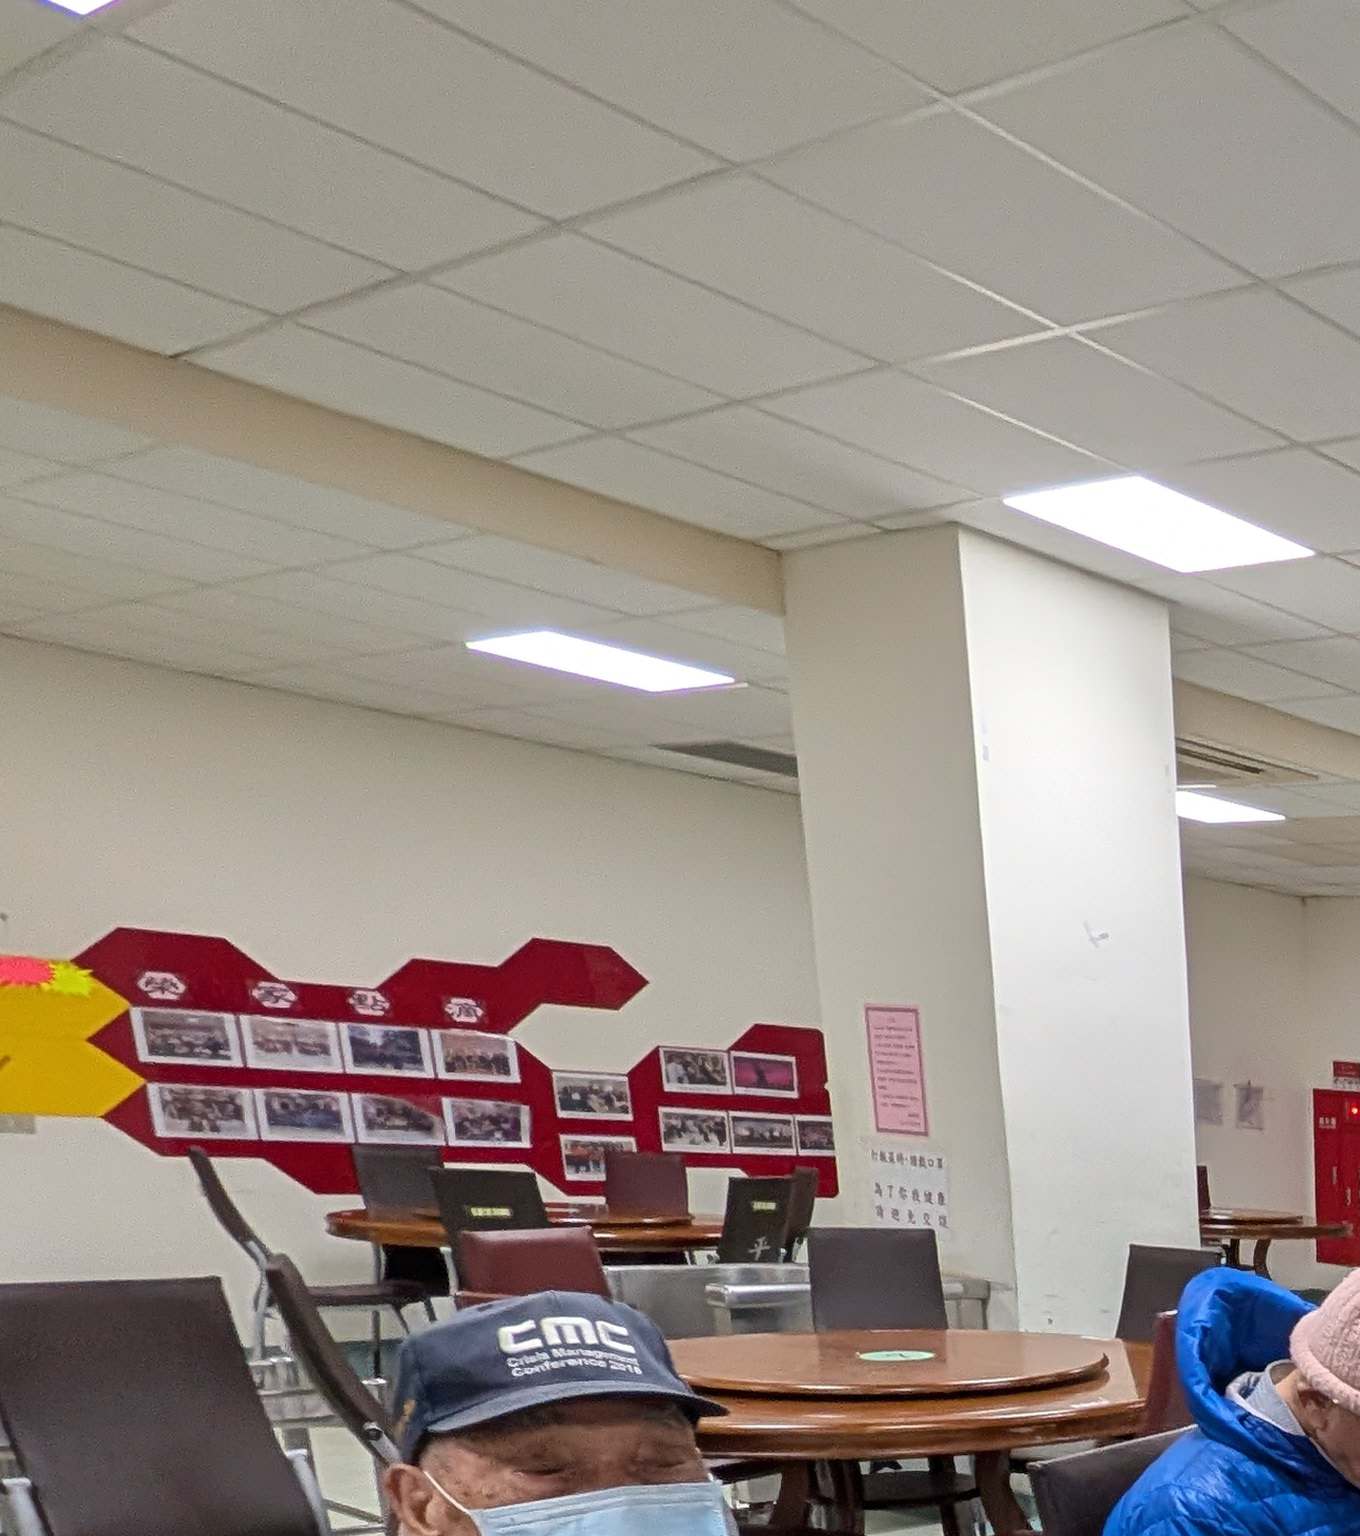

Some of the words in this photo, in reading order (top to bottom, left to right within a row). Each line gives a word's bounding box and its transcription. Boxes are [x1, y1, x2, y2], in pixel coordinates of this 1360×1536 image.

[497, 1316, 636, 1354] CMC
[506, 1352, 551, 1368] Crisis
[551, 1347, 640, 1367] Management
[511, 1358, 608, 1377] Conference
